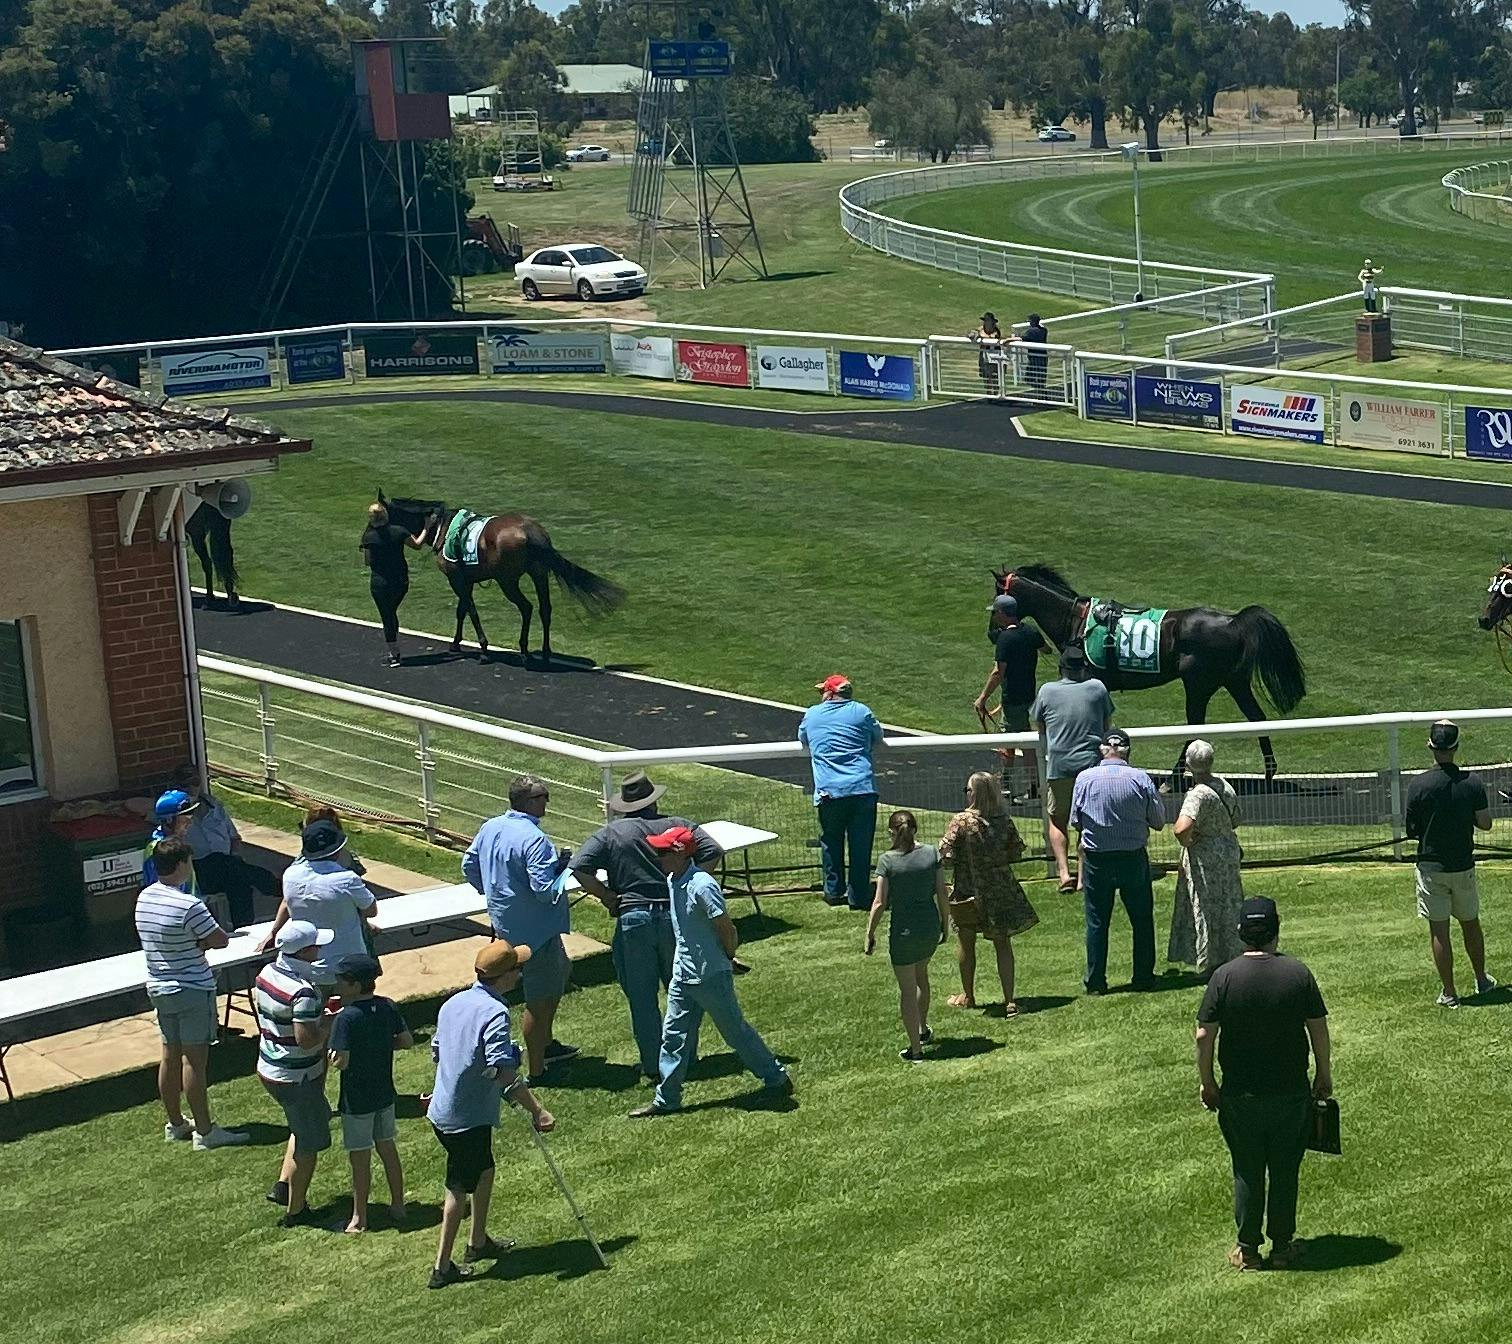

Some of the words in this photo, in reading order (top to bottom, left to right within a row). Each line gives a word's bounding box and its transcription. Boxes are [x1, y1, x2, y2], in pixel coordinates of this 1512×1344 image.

[503, 348, 538, 359] LOAM
[543, 348, 551, 359] &
[554, 348, 593, 359] STONE
[370, 356, 474, 367] HARRISONS
[779, 356, 824, 372] Gallagher
[844, 377, 859, 385] ALAN
[860, 379, 878, 387] HARRIS
[1157, 382, 1194, 392] WHEN
[1154, 388, 1213, 402] NEWS
[1237, 399, 1319, 423] SIGNMAKERS
[1365, 402, 1402, 416] WILLIAM
[1404, 406, 1436, 419] FARRER
[1398, 438, 1415, 446] 6921
